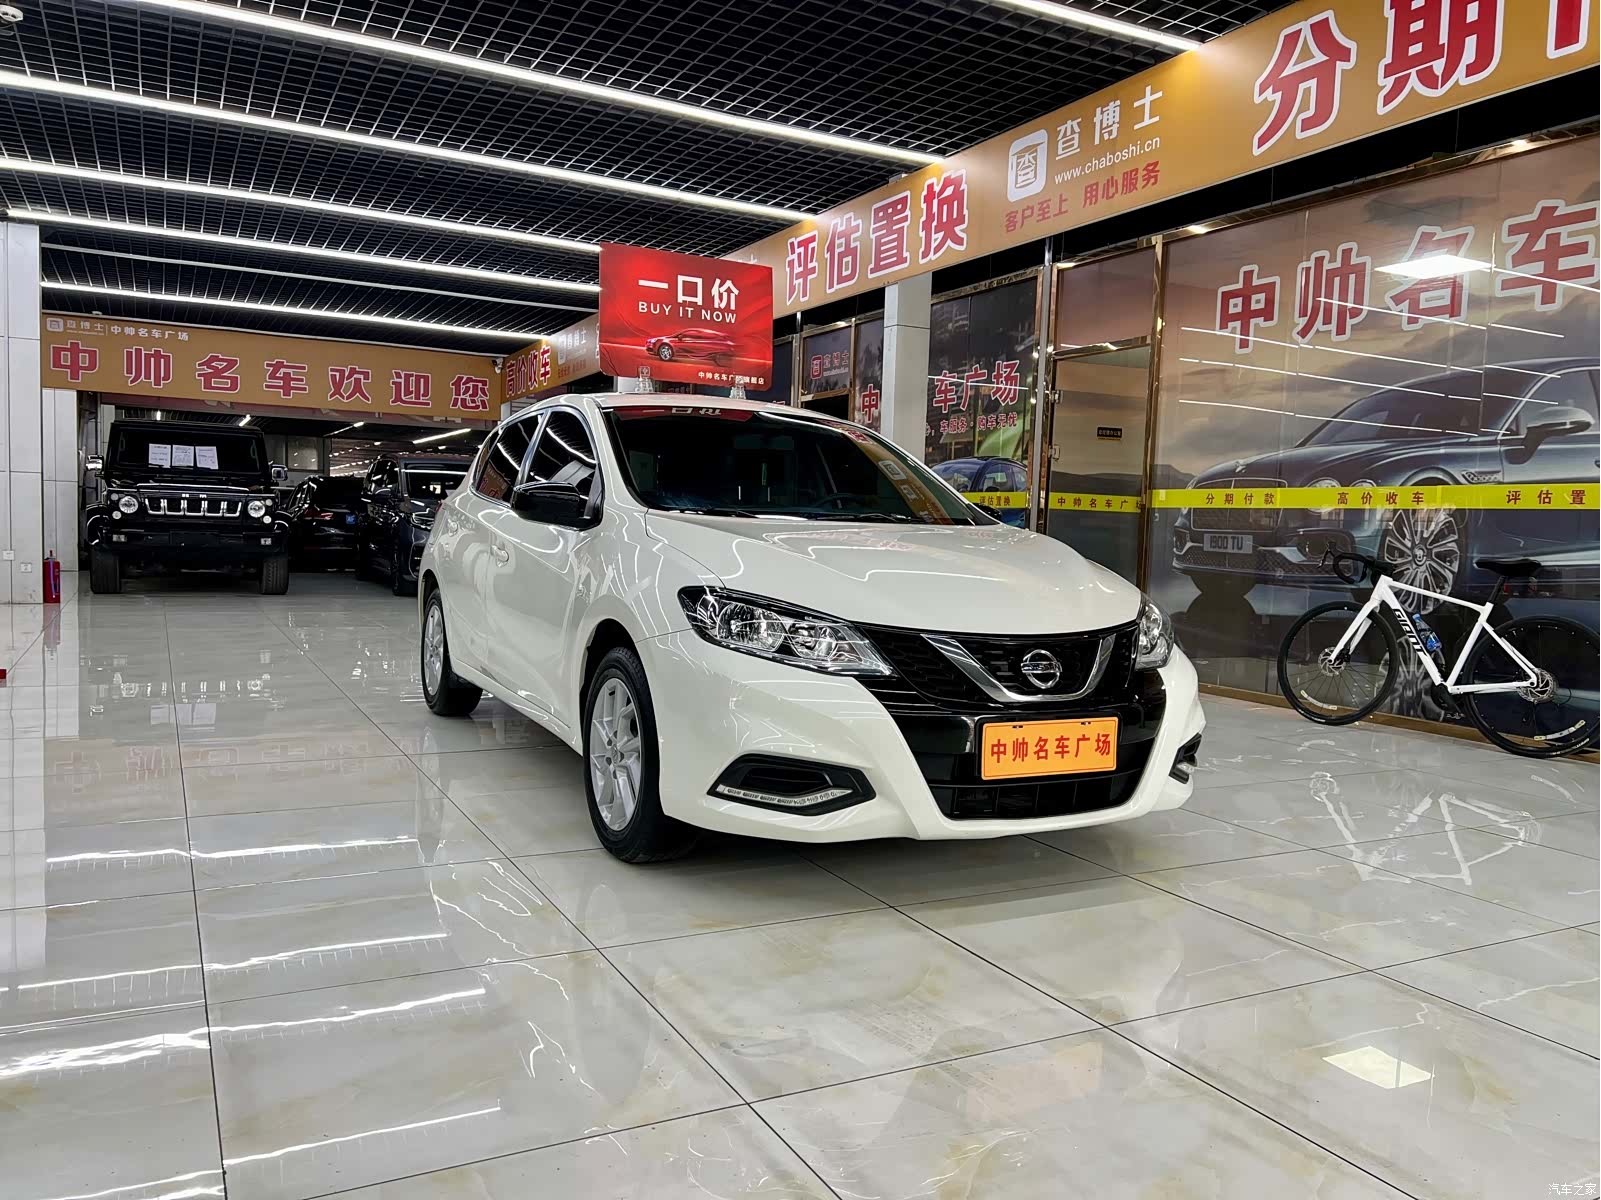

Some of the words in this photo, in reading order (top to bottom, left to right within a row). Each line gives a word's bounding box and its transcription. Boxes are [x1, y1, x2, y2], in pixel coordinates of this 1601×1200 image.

[1252, 0, 1592, 156] 分期
[1056, 85, 1163, 160] 查博士
[1054, 137, 1160, 185] www.chaboshi.cn
[1005, 194, 1068, 233] 客户至上
[1083, 160, 1160, 208] 用心服务
[786, 169, 969, 306] 评估置换
[638, 274, 740, 311] 一口价
[1216, 200, 1600, 355] 中帅名车
[110, 324, 190, 342] 中帅名车广场
[638, 301, 672, 316] BUY
[679, 306, 694, 319] IT
[701, 309, 737, 324] NOW
[51, 340, 489, 411] 中帅名车欢迎您
[506, 344, 551, 398] 高价收车
[933, 360, 1020, 413] 车广场
[979, 495, 1011, 507] 评估置换
[1205, 492, 1275, 505] 分期付款
[1337, 491, 1425, 505] 高价收车
[1506, 489, 1587, 505] 评估置
[990, 732, 1112, 764] 中帅名车广场
